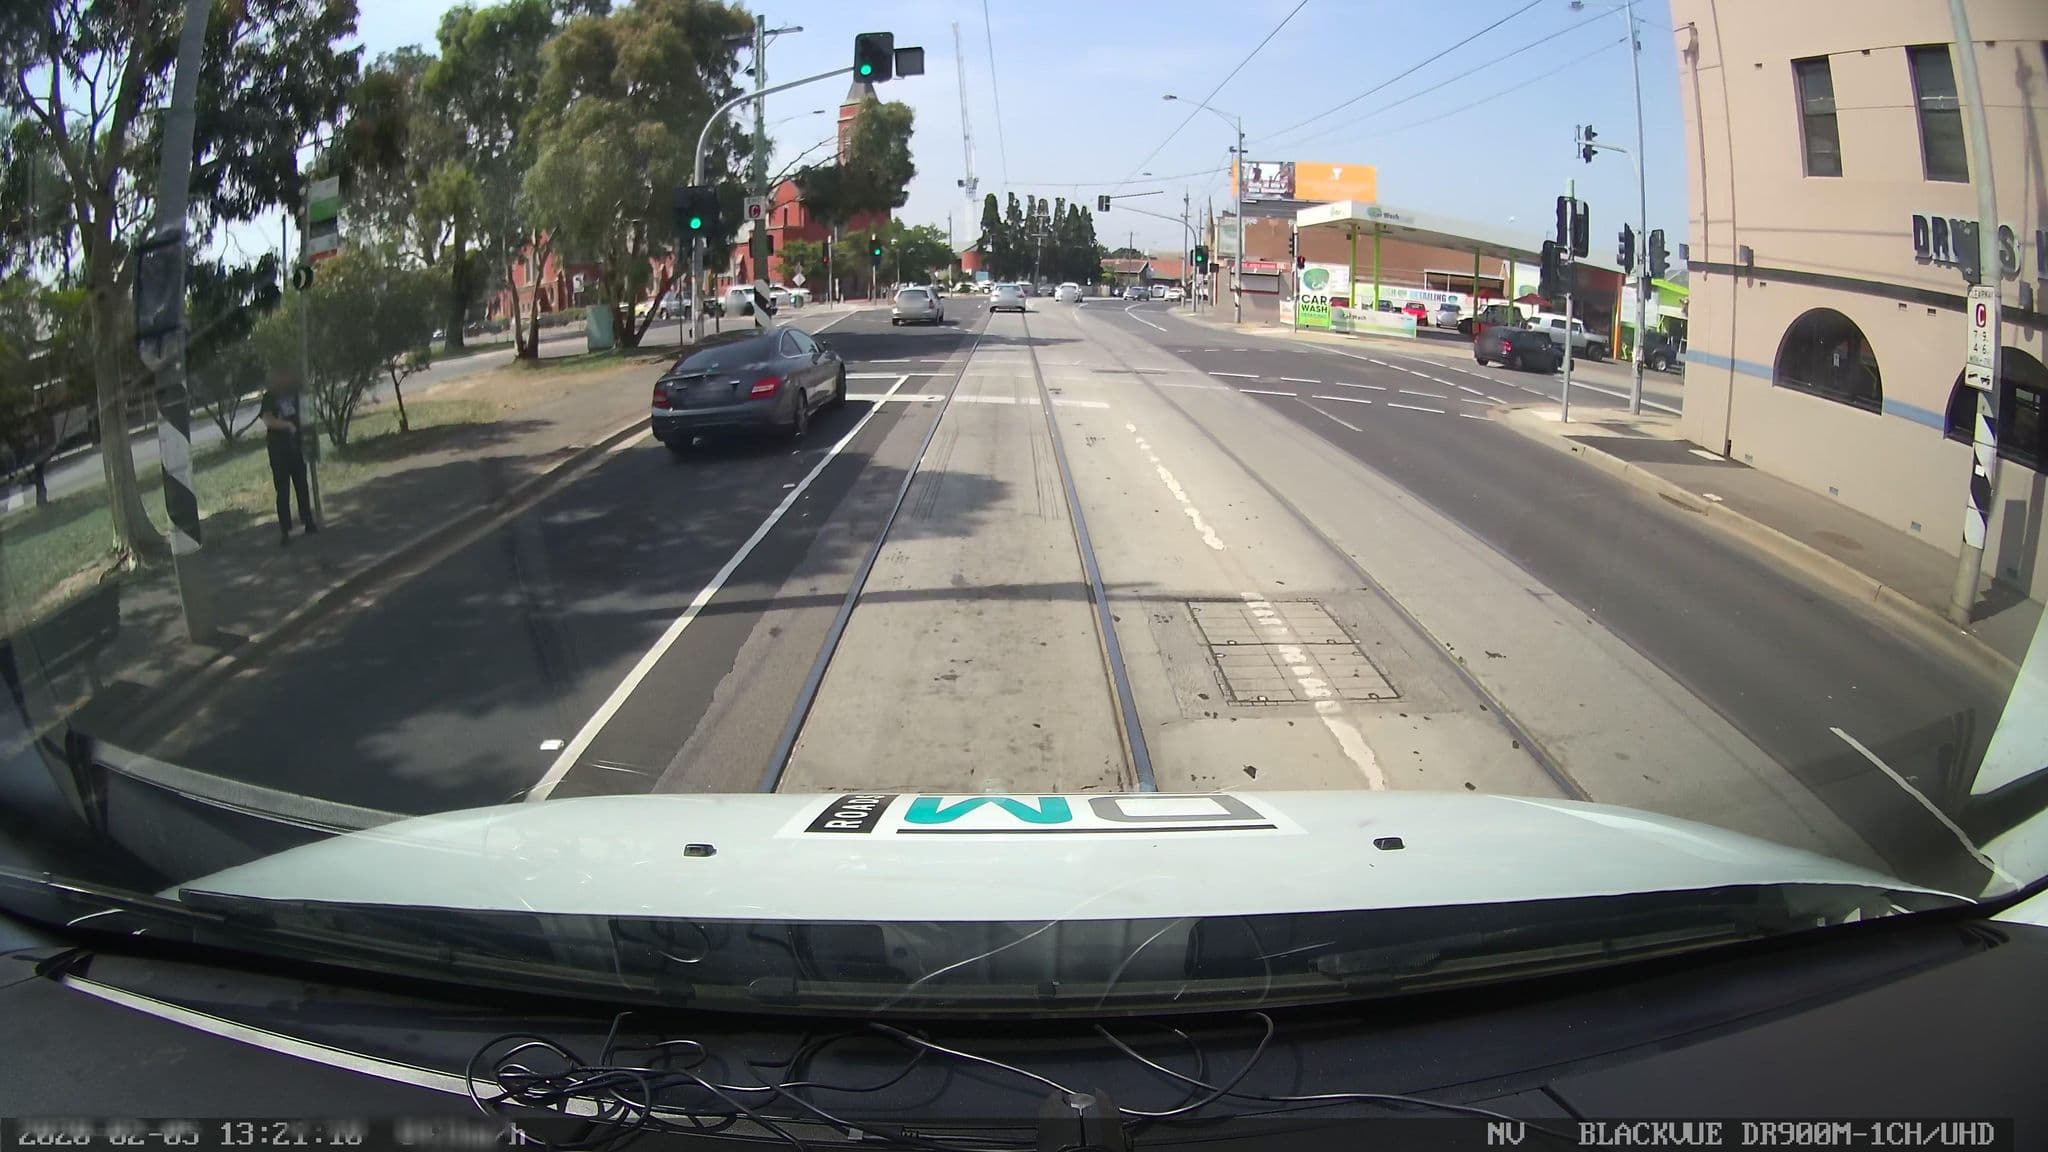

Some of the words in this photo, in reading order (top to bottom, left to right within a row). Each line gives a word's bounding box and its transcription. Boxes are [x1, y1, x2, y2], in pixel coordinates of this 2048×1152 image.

[1301, 294, 1328, 306] CAR
[1301, 303, 1328, 314] WASH
[825, 795, 887, 830] ROADS
